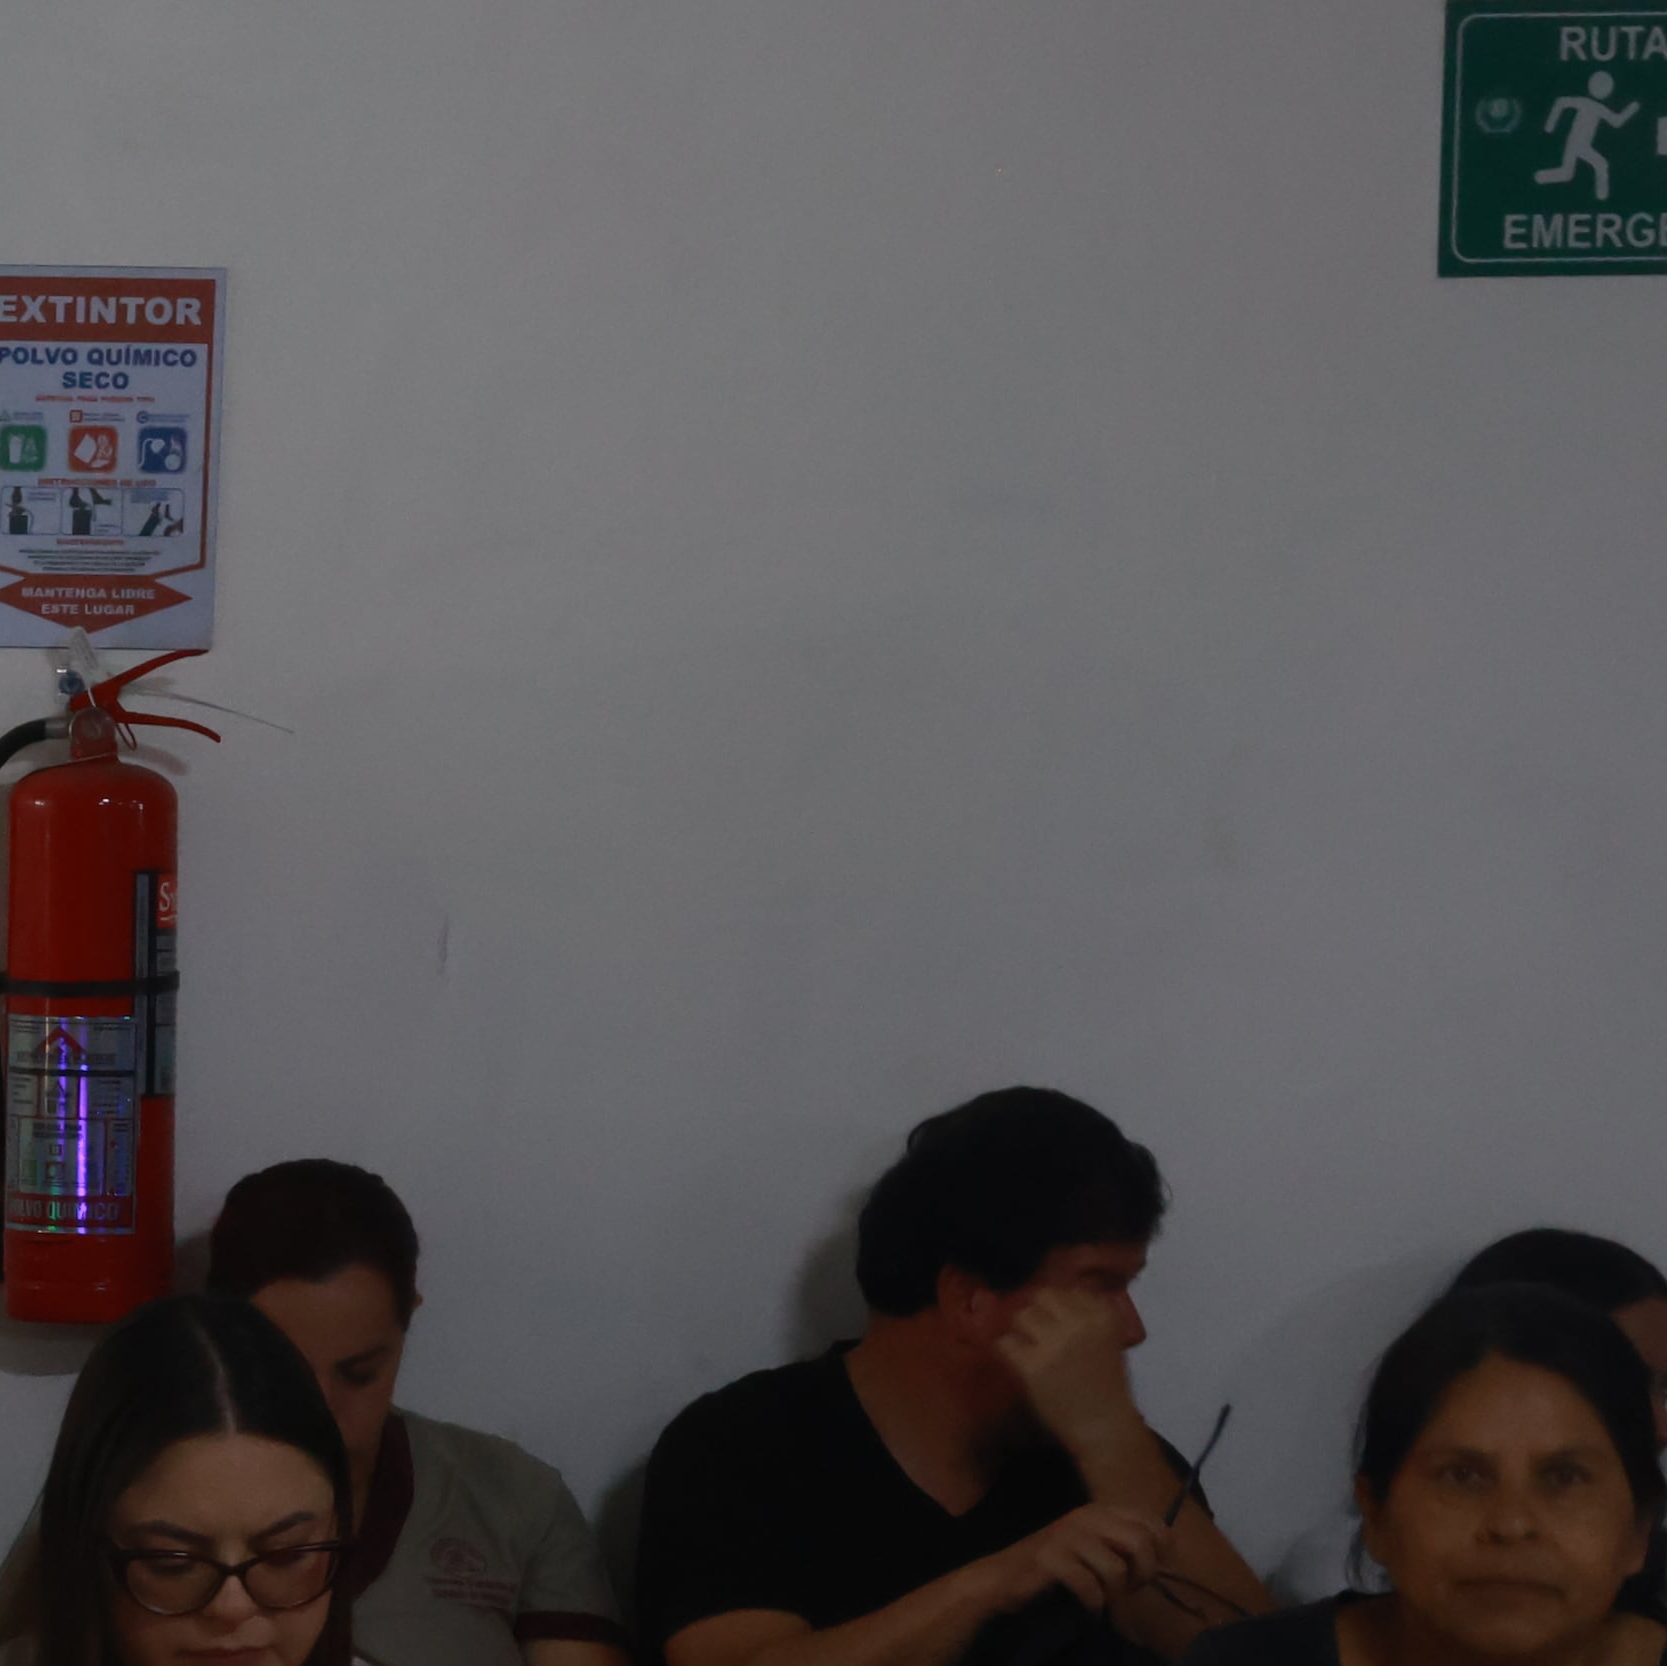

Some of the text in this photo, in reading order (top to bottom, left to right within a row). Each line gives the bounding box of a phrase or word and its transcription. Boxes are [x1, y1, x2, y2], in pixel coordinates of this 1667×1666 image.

[1559, 25, 1667, 62] RUTA
[1502, 212, 1667, 249] EMERG
[86, 345, 198, 368] QUÍMICO
[61, 371, 130, 390] SECO
[21, 586, 107, 600] MANTENGA
[40, 603, 136, 616] ESTE LUGAR
